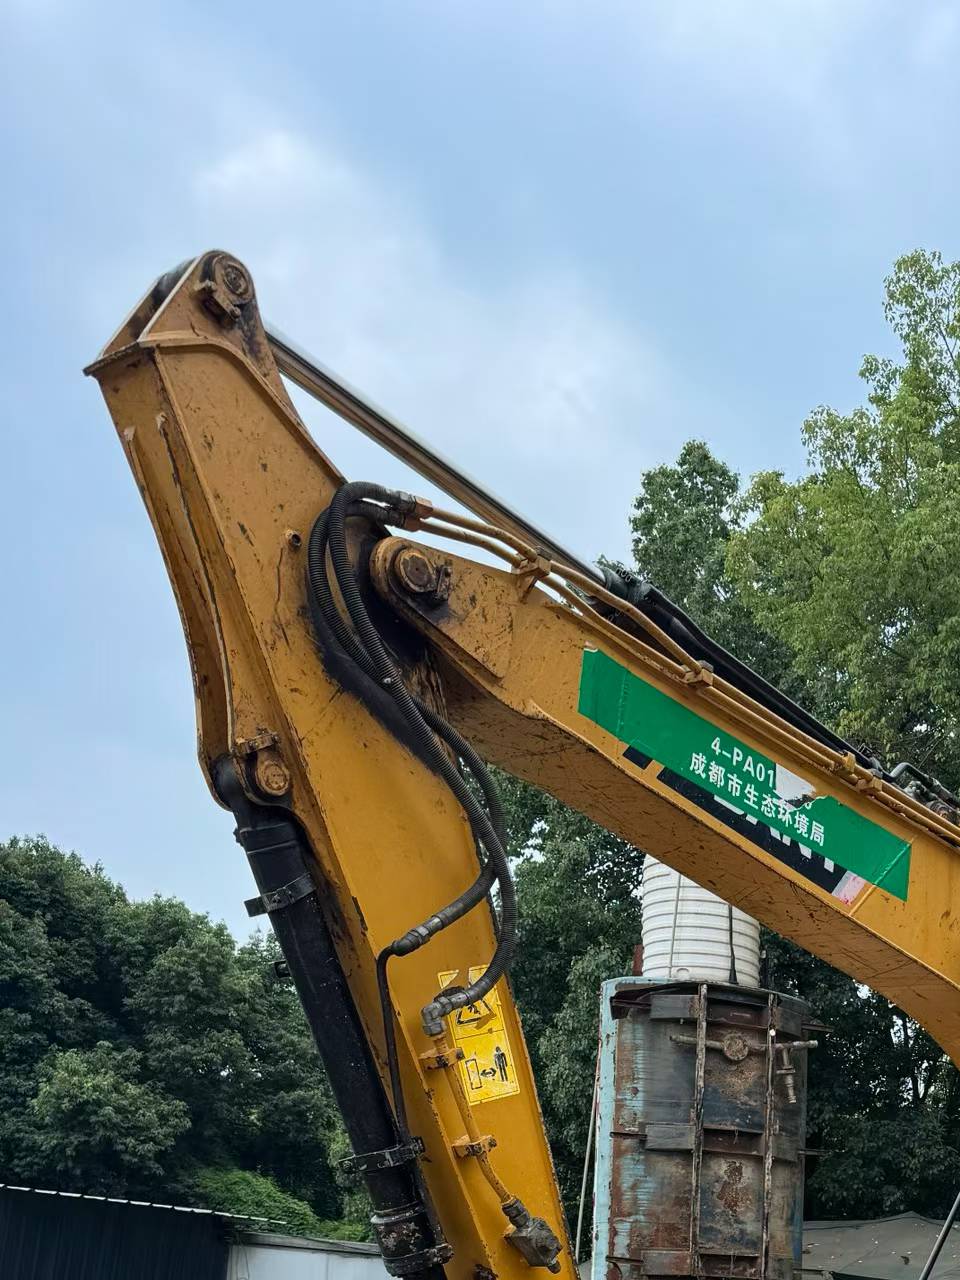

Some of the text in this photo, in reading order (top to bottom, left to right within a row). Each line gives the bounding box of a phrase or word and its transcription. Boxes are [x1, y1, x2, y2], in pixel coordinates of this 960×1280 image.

[690, 753, 825, 847] 成都市生态环境局
